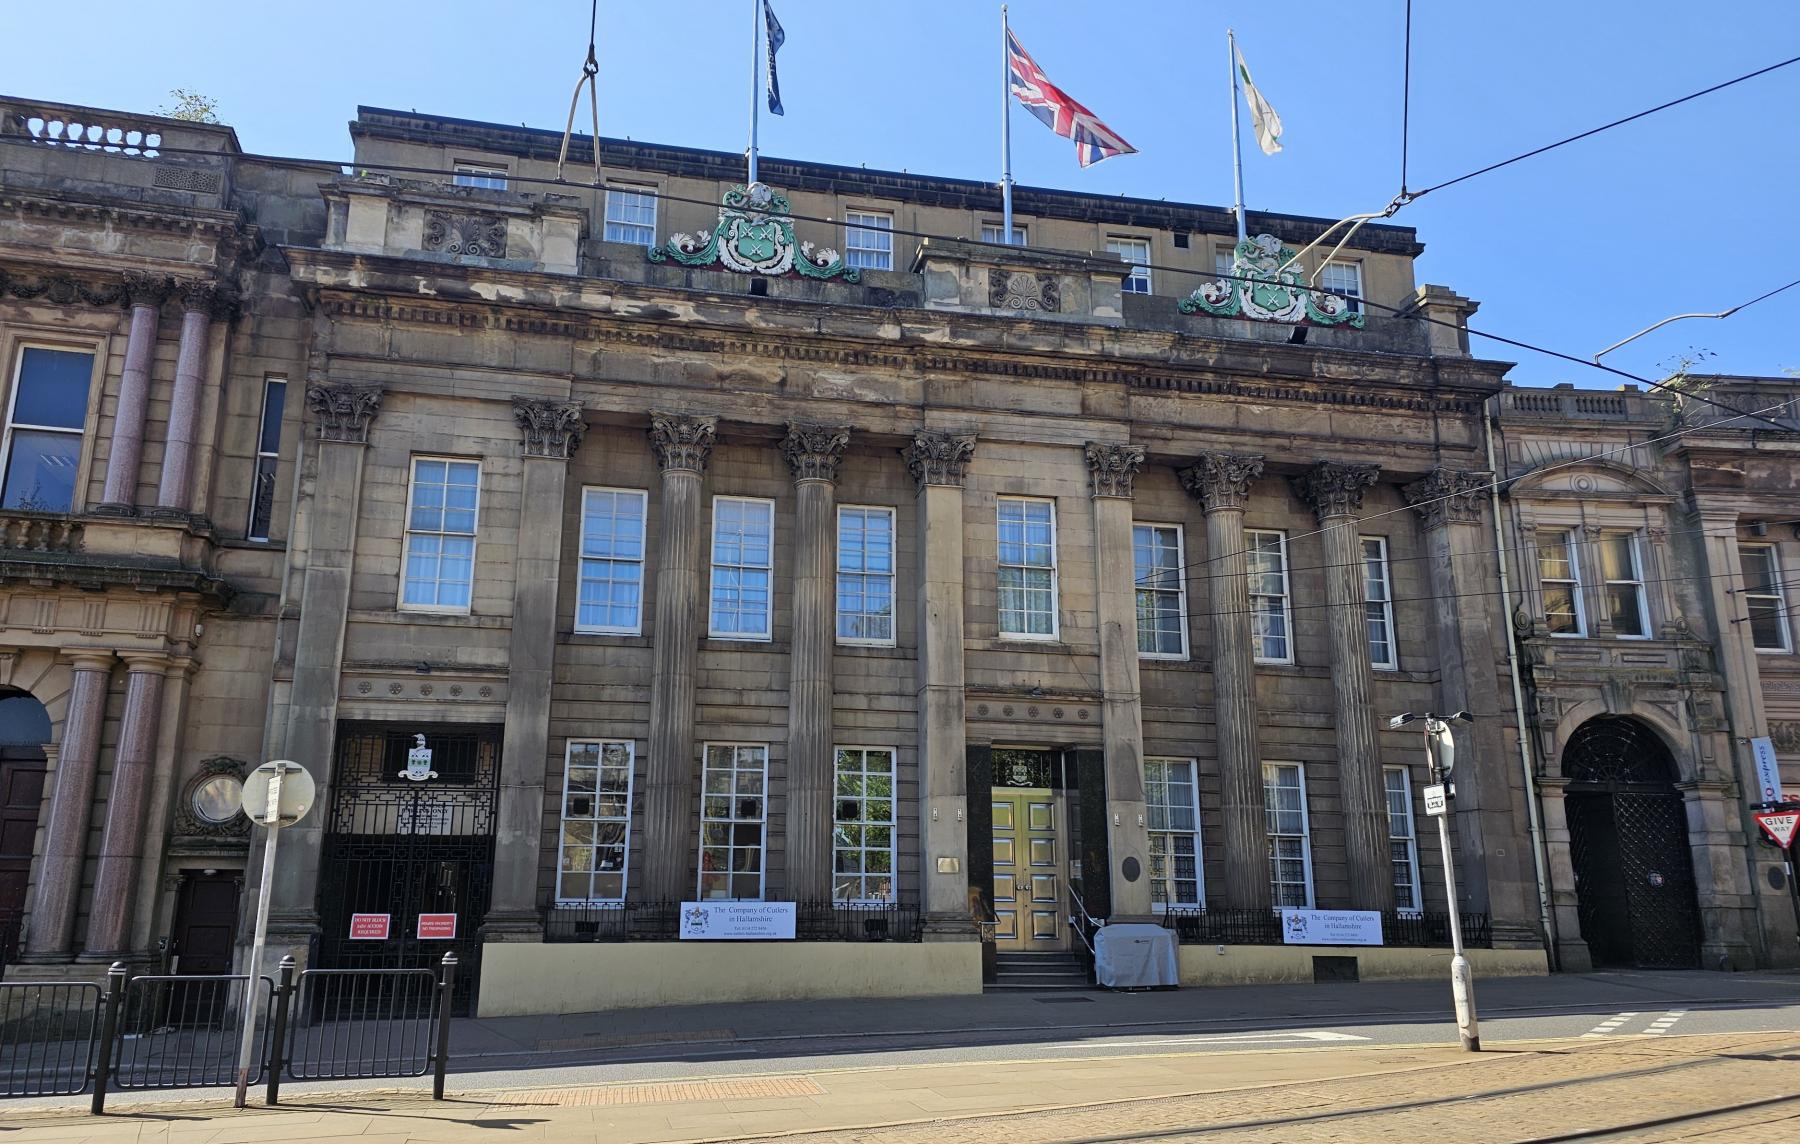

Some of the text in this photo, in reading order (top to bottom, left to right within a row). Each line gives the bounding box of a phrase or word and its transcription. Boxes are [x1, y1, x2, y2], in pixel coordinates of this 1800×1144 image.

[1759, 745, 1771, 784] express
[1765, 816, 1793, 826] GIVE
[729, 906, 757, 915] Company
[1323, 914, 1348, 923] Company
